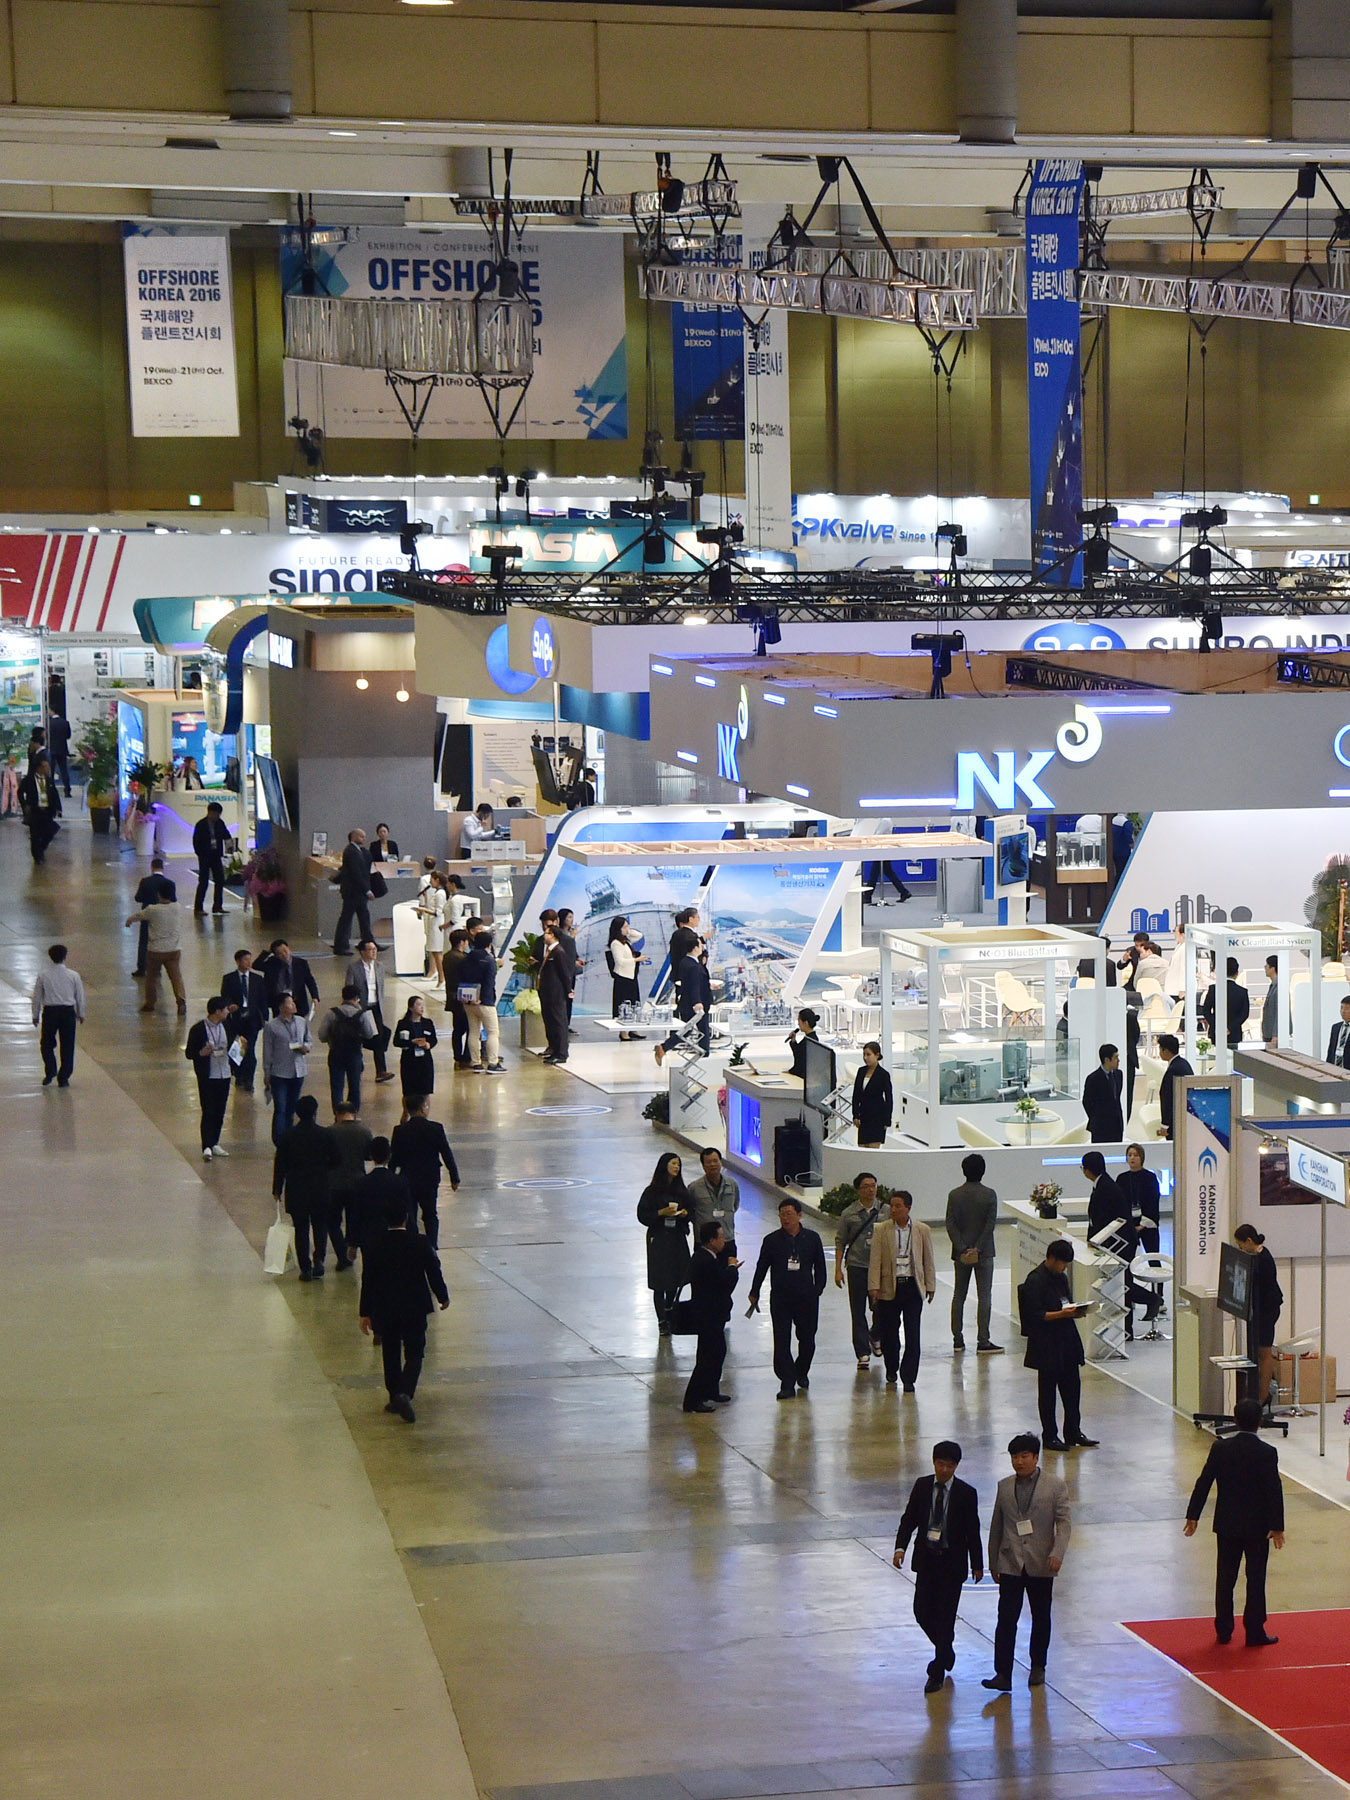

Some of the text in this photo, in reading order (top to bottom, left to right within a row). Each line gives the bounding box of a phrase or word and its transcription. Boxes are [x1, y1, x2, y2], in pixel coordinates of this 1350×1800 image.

[138, 270, 219, 285] OFFSHORE
[368, 258, 540, 292] OFFSHOE
[1031, 270, 1069, 300] 플랜트전시
[139, 288, 221, 301] KOREA 2016
[140, 309, 194, 323] 국제해양
[141, 327, 221, 340] 플랜트전시회
[298, 556, 358, 565] FUTURE
[717, 722, 740, 783] NK
[953, 750, 1056, 810] NK
[1309, 1159, 1329, 1175] KANGNAM
[1310, 1172, 1337, 1193] CORPORATION
[1208, 1185, 1216, 1235] KANGNAM
